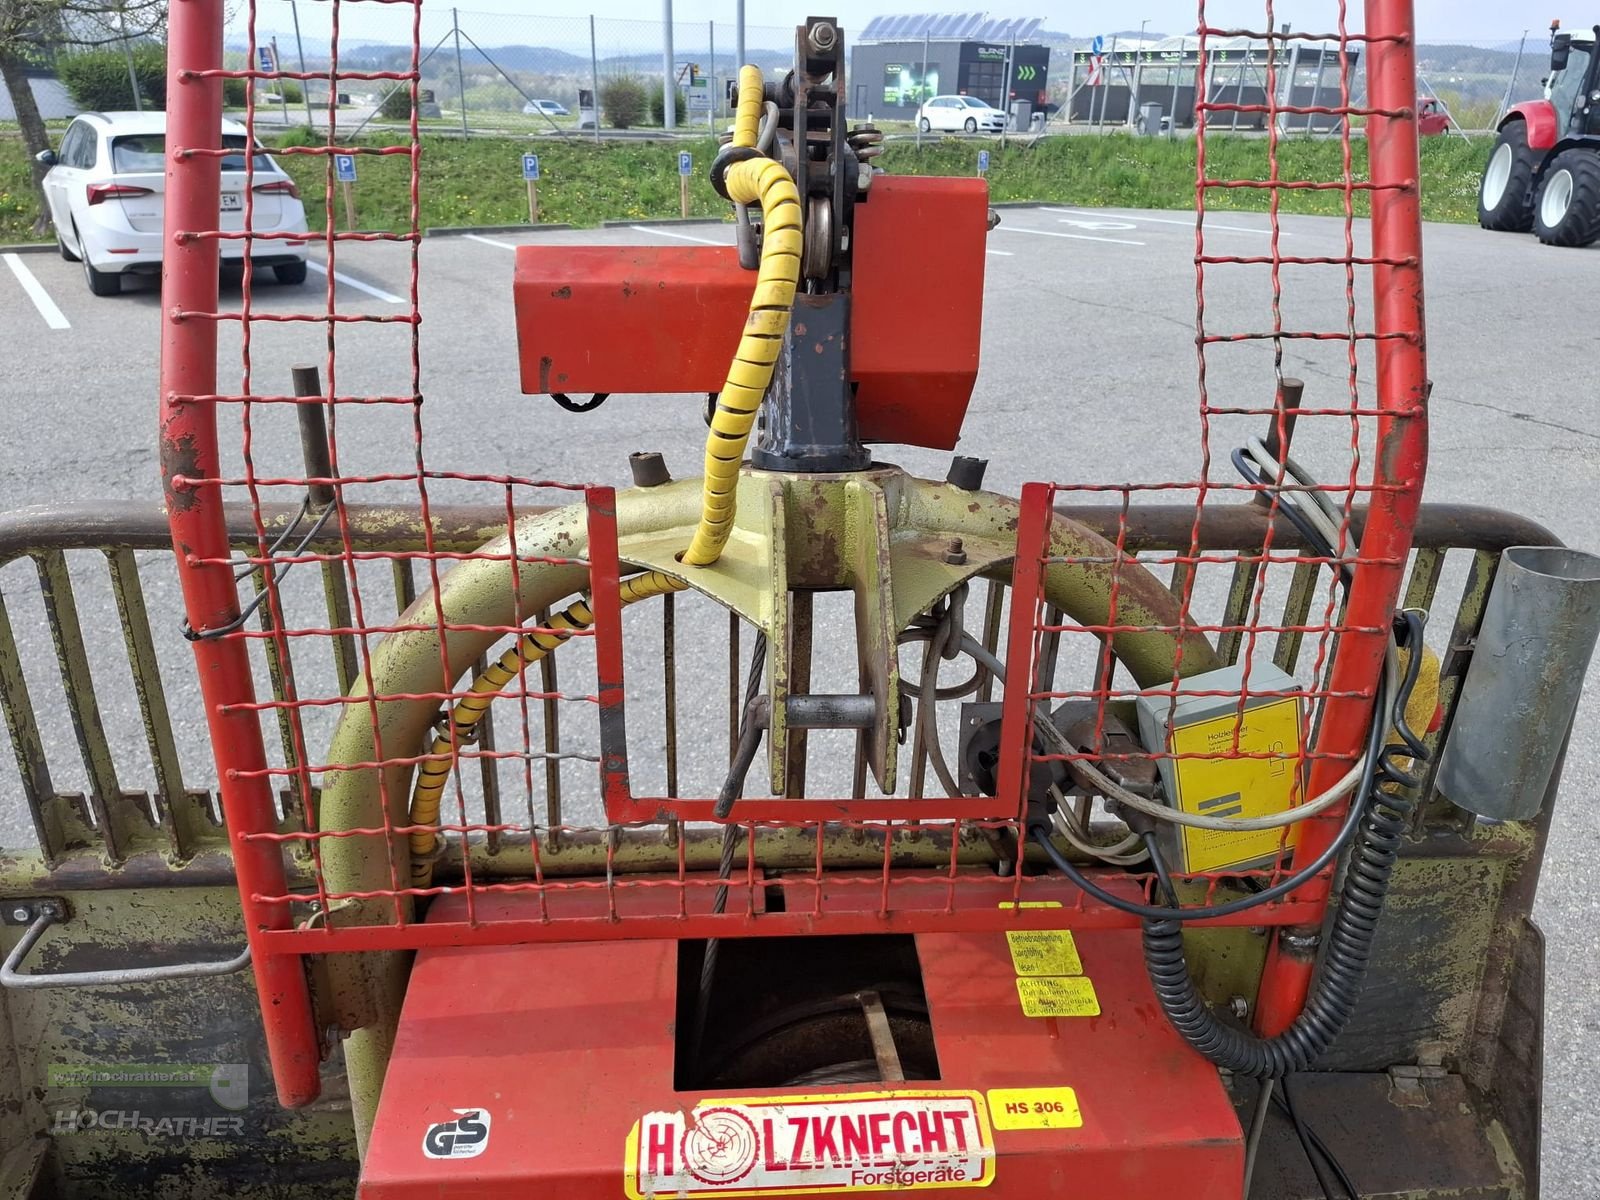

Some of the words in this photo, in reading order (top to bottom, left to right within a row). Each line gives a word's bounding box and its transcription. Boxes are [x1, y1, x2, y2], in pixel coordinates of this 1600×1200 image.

[340, 158, 350, 171] P
[526, 158, 535, 170] P
[681, 156, 689, 168] P
[1005, 1102, 1029, 1114] HS
[1034, 1102, 1064, 1114] 306
[426, 1111, 487, 1156] GS
[851, 1167, 966, 1186] Forstgeräte
